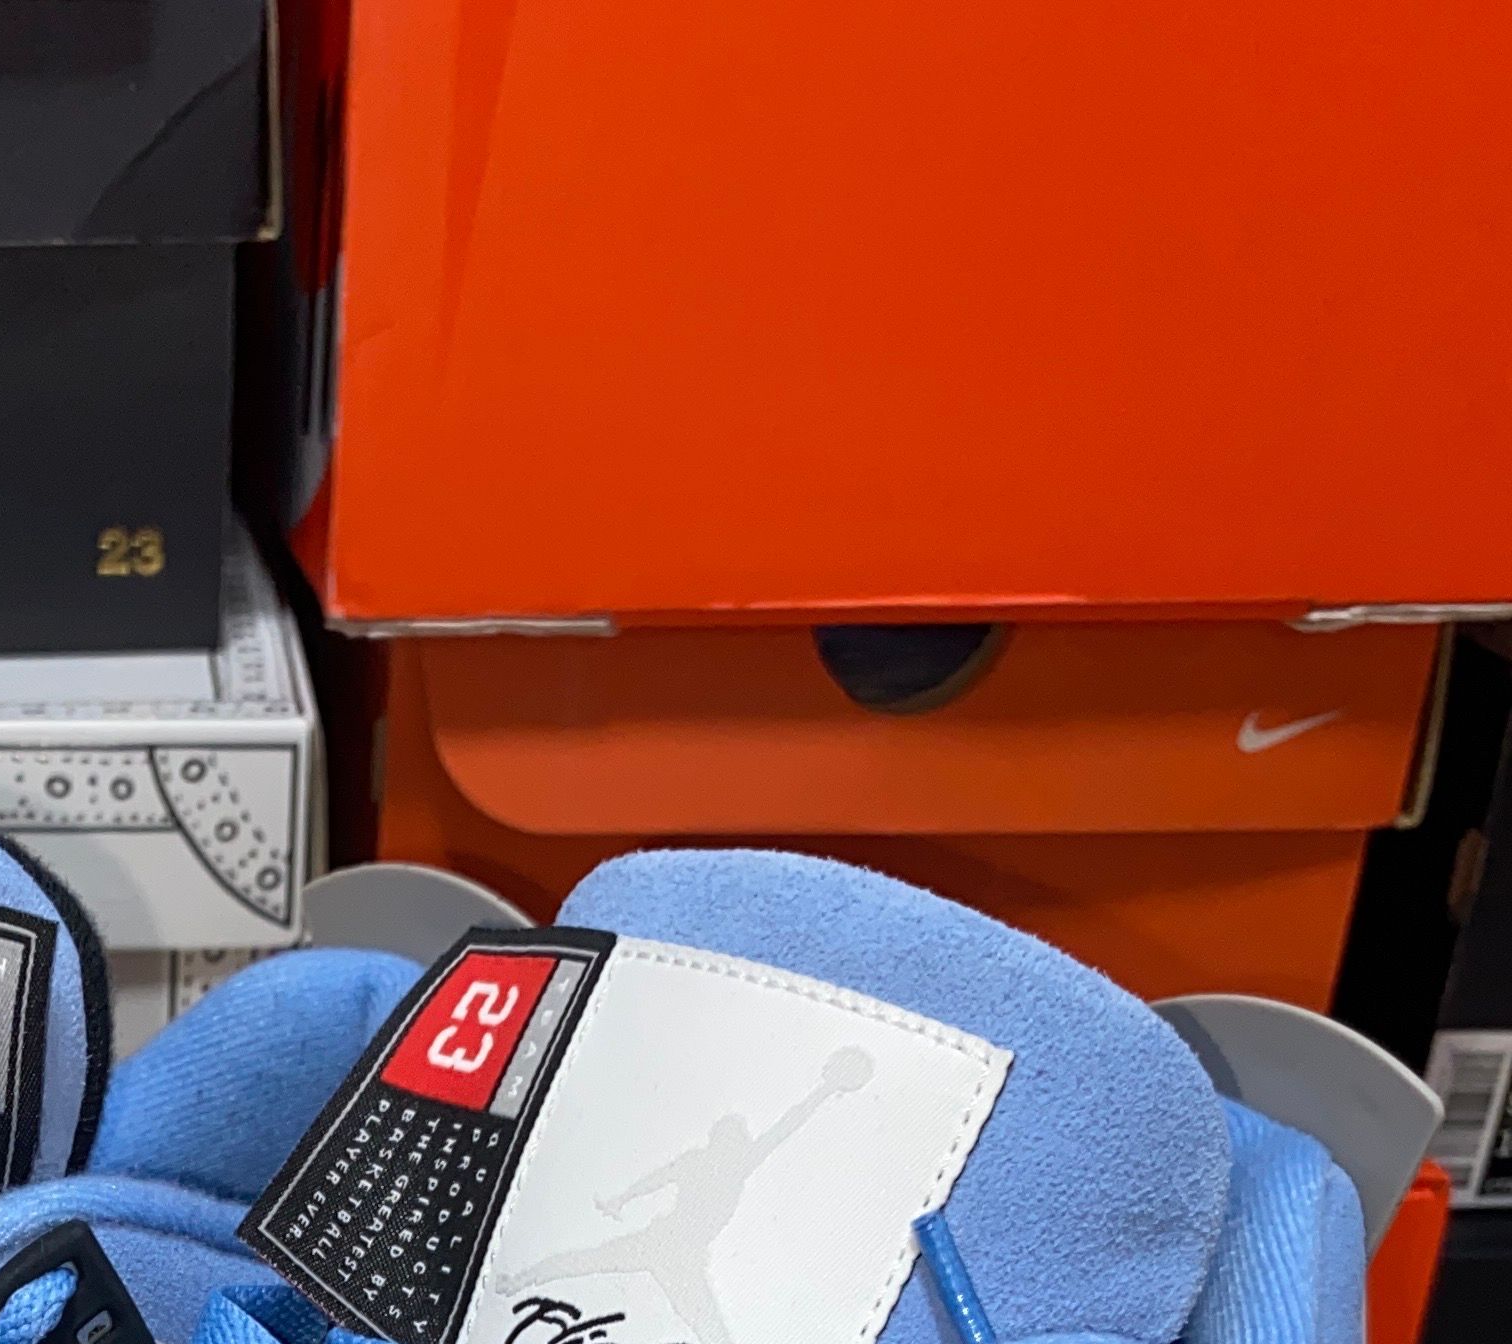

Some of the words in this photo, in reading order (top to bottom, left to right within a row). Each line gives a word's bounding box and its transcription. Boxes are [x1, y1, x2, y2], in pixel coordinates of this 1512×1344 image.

[96, 526, 166, 577] 23
[427, 980, 519, 1073] 23
[507, 977, 570, 1097] TEAM
[312, 1108, 416, 1260] BASKETBALL
[325, 1098, 391, 1185] PLAYER
[390, 1122, 463, 1259] INSPIRED
[408, 1117, 441, 1165] THE
[337, 1174, 410, 1282] GREATEST
[388, 1127, 482, 1320] PRODUCTS
[413, 1129, 501, 1334] QUALITY
[363, 1274, 387, 1302] BY
